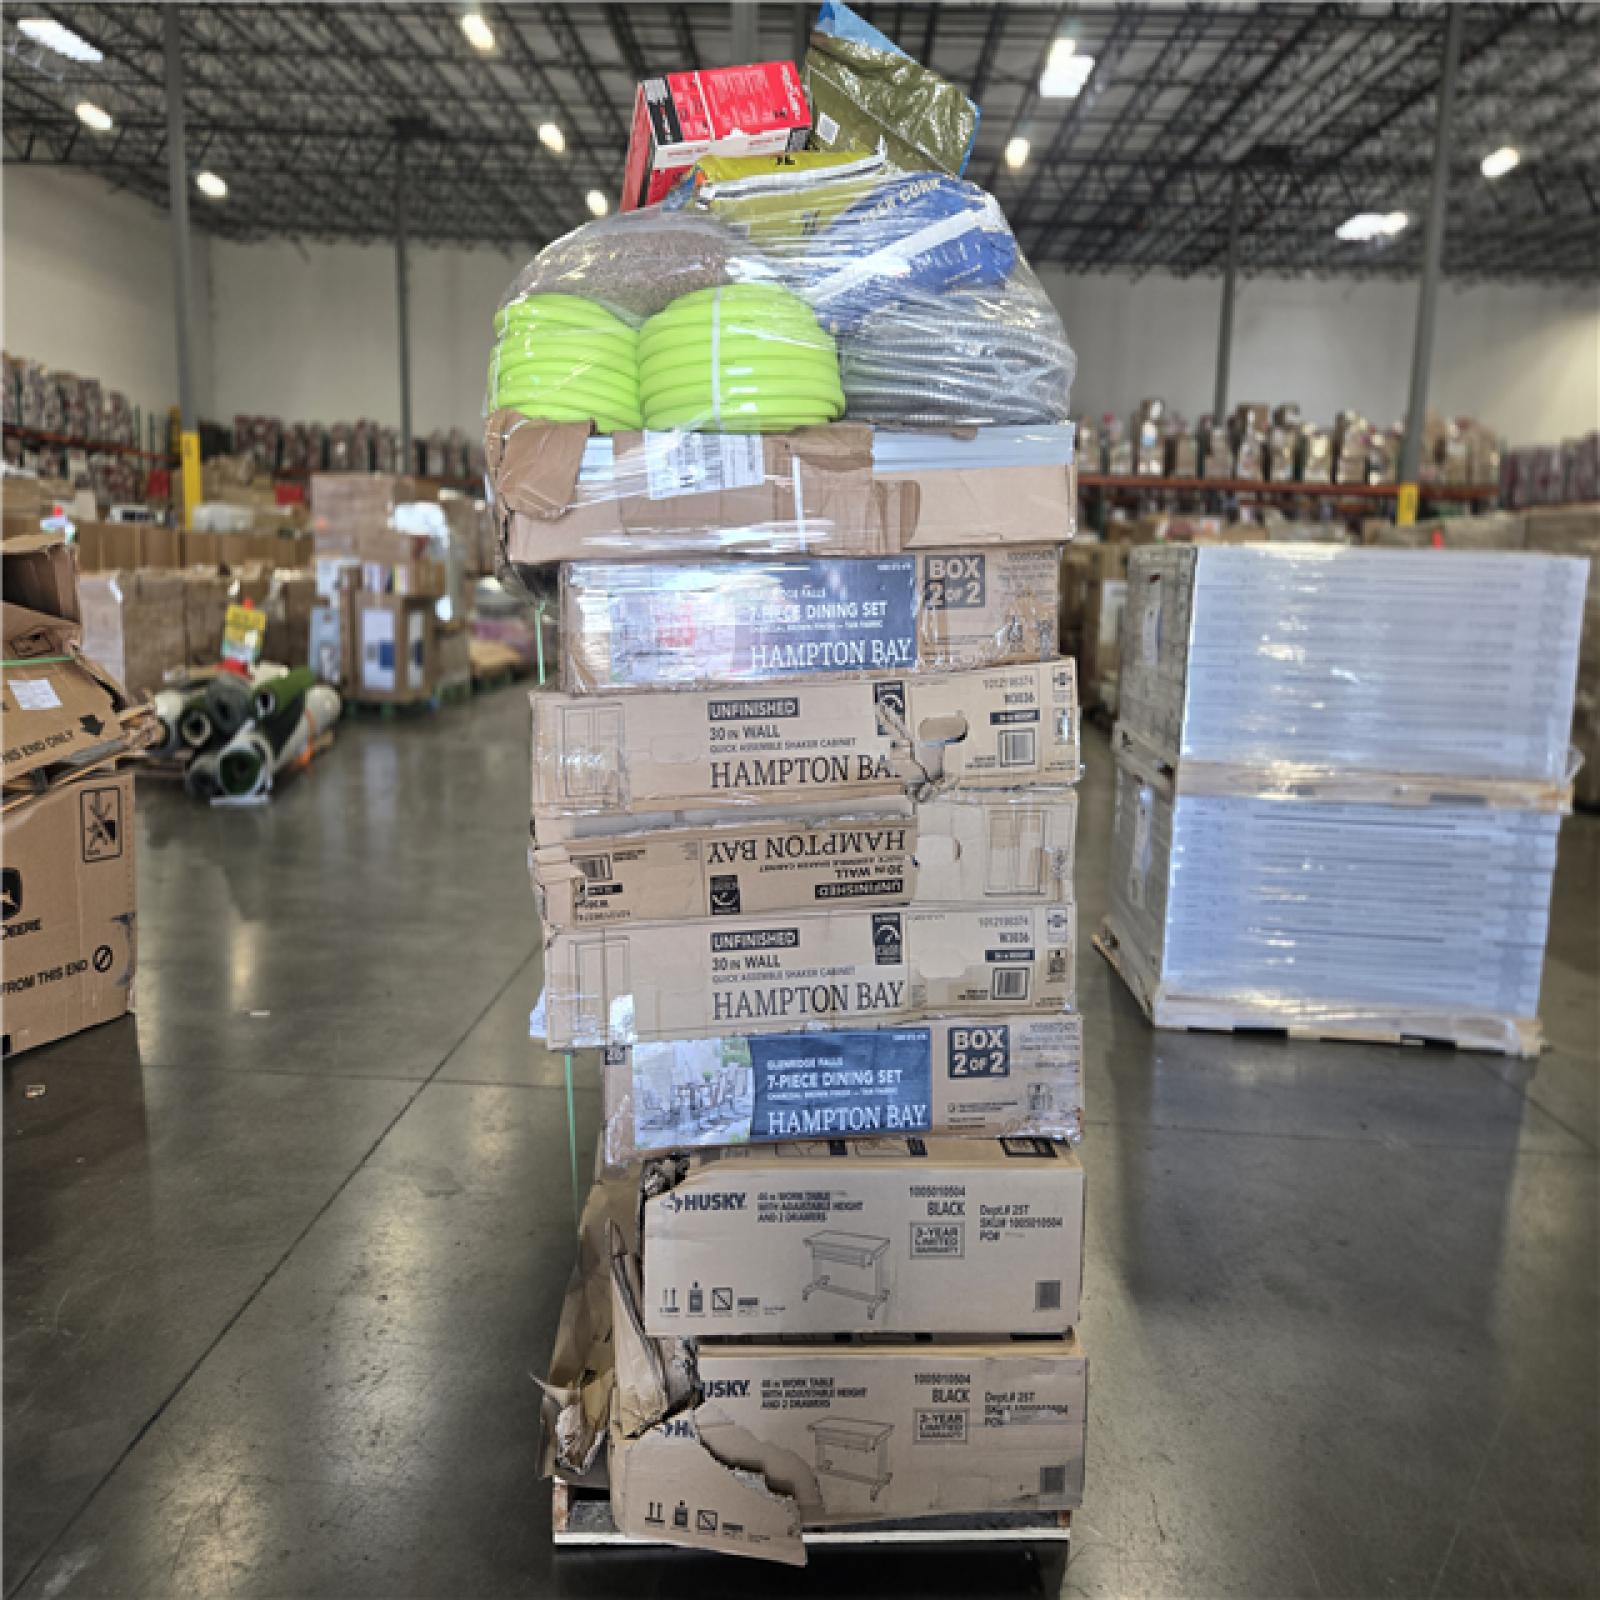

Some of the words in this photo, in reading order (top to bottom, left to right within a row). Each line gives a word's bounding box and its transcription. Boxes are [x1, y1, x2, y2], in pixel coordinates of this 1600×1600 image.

[928, 558, 981, 580] BOX
[927, 581, 944, 606] 2
[965, 581, 982, 604] 2
[806, 602, 859, 620] DINING
[862, 600, 888, 617] SET
[751, 639, 866, 669] HAMPTON
[871, 637, 914, 665] BAY
[711, 701, 796, 720] UNFINISHED
[709, 727, 726, 740] 30
[741, 724, 781, 738] WALL
[784, 739, 819, 750] SHAKER
[819, 737, 856, 748] CABINET
[710, 755, 851, 789] HAMPTON
[855, 753, 902, 781] BA
[706, 839, 758, 864] BAY
[764, 829, 905, 858] HAMPTON
[834, 867, 871, 880] WALL
[886, 864, 904, 876] 30
[816, 881, 903, 900] UNFINISHED
[713, 930, 796, 950] UNFINISHED
[37, 966, 63, 984] THIS
[65, 959, 88, 976] END
[711, 957, 728, 970] 30
[744, 955, 781, 968] WALL
[784, 968, 818, 979] SHAKER
[819, 966, 855, 977] CABINET
[712, 984, 849, 1020] HAMPTON
[856, 980, 904, 1010] BAY
[953, 1029, 1004, 1051] BOX
[952, 1052, 968, 1076] 2
[989, 1050, 1004, 1073] 2
[767, 1072, 818, 1090] 7-PIECE
[821, 1069, 873, 1086] DINING
[877, 1068, 903, 1084] SET
[767, 1105, 881, 1136] HAMPTON
[886, 1103, 929, 1129] BAY
[683, 1191, 748, 1211] HUSKY
[780, 1201, 831, 1211] ADJUSTABLE
[832, 1201, 863, 1211] HEIGHT
[927, 1202, 966, 1216] BLACK
[758, 1213, 777, 1222] AND
[785, 1212, 828, 1222] DRAWERS
[979, 1217, 1006, 1228] SKU#
[979, 1230, 1001, 1241] PO#
[698, 1379, 750, 1398] USKY
[809, 1377, 833, 1387] TABLE
[784, 1389, 834, 1398] ADJUSTABLE
[837, 1387, 867, 1397] HEIGHT
[932, 1388, 970, 1403] BLACK
[761, 1400, 780, 1409] AND
[789, 1400, 831, 1408] DRAWERS
